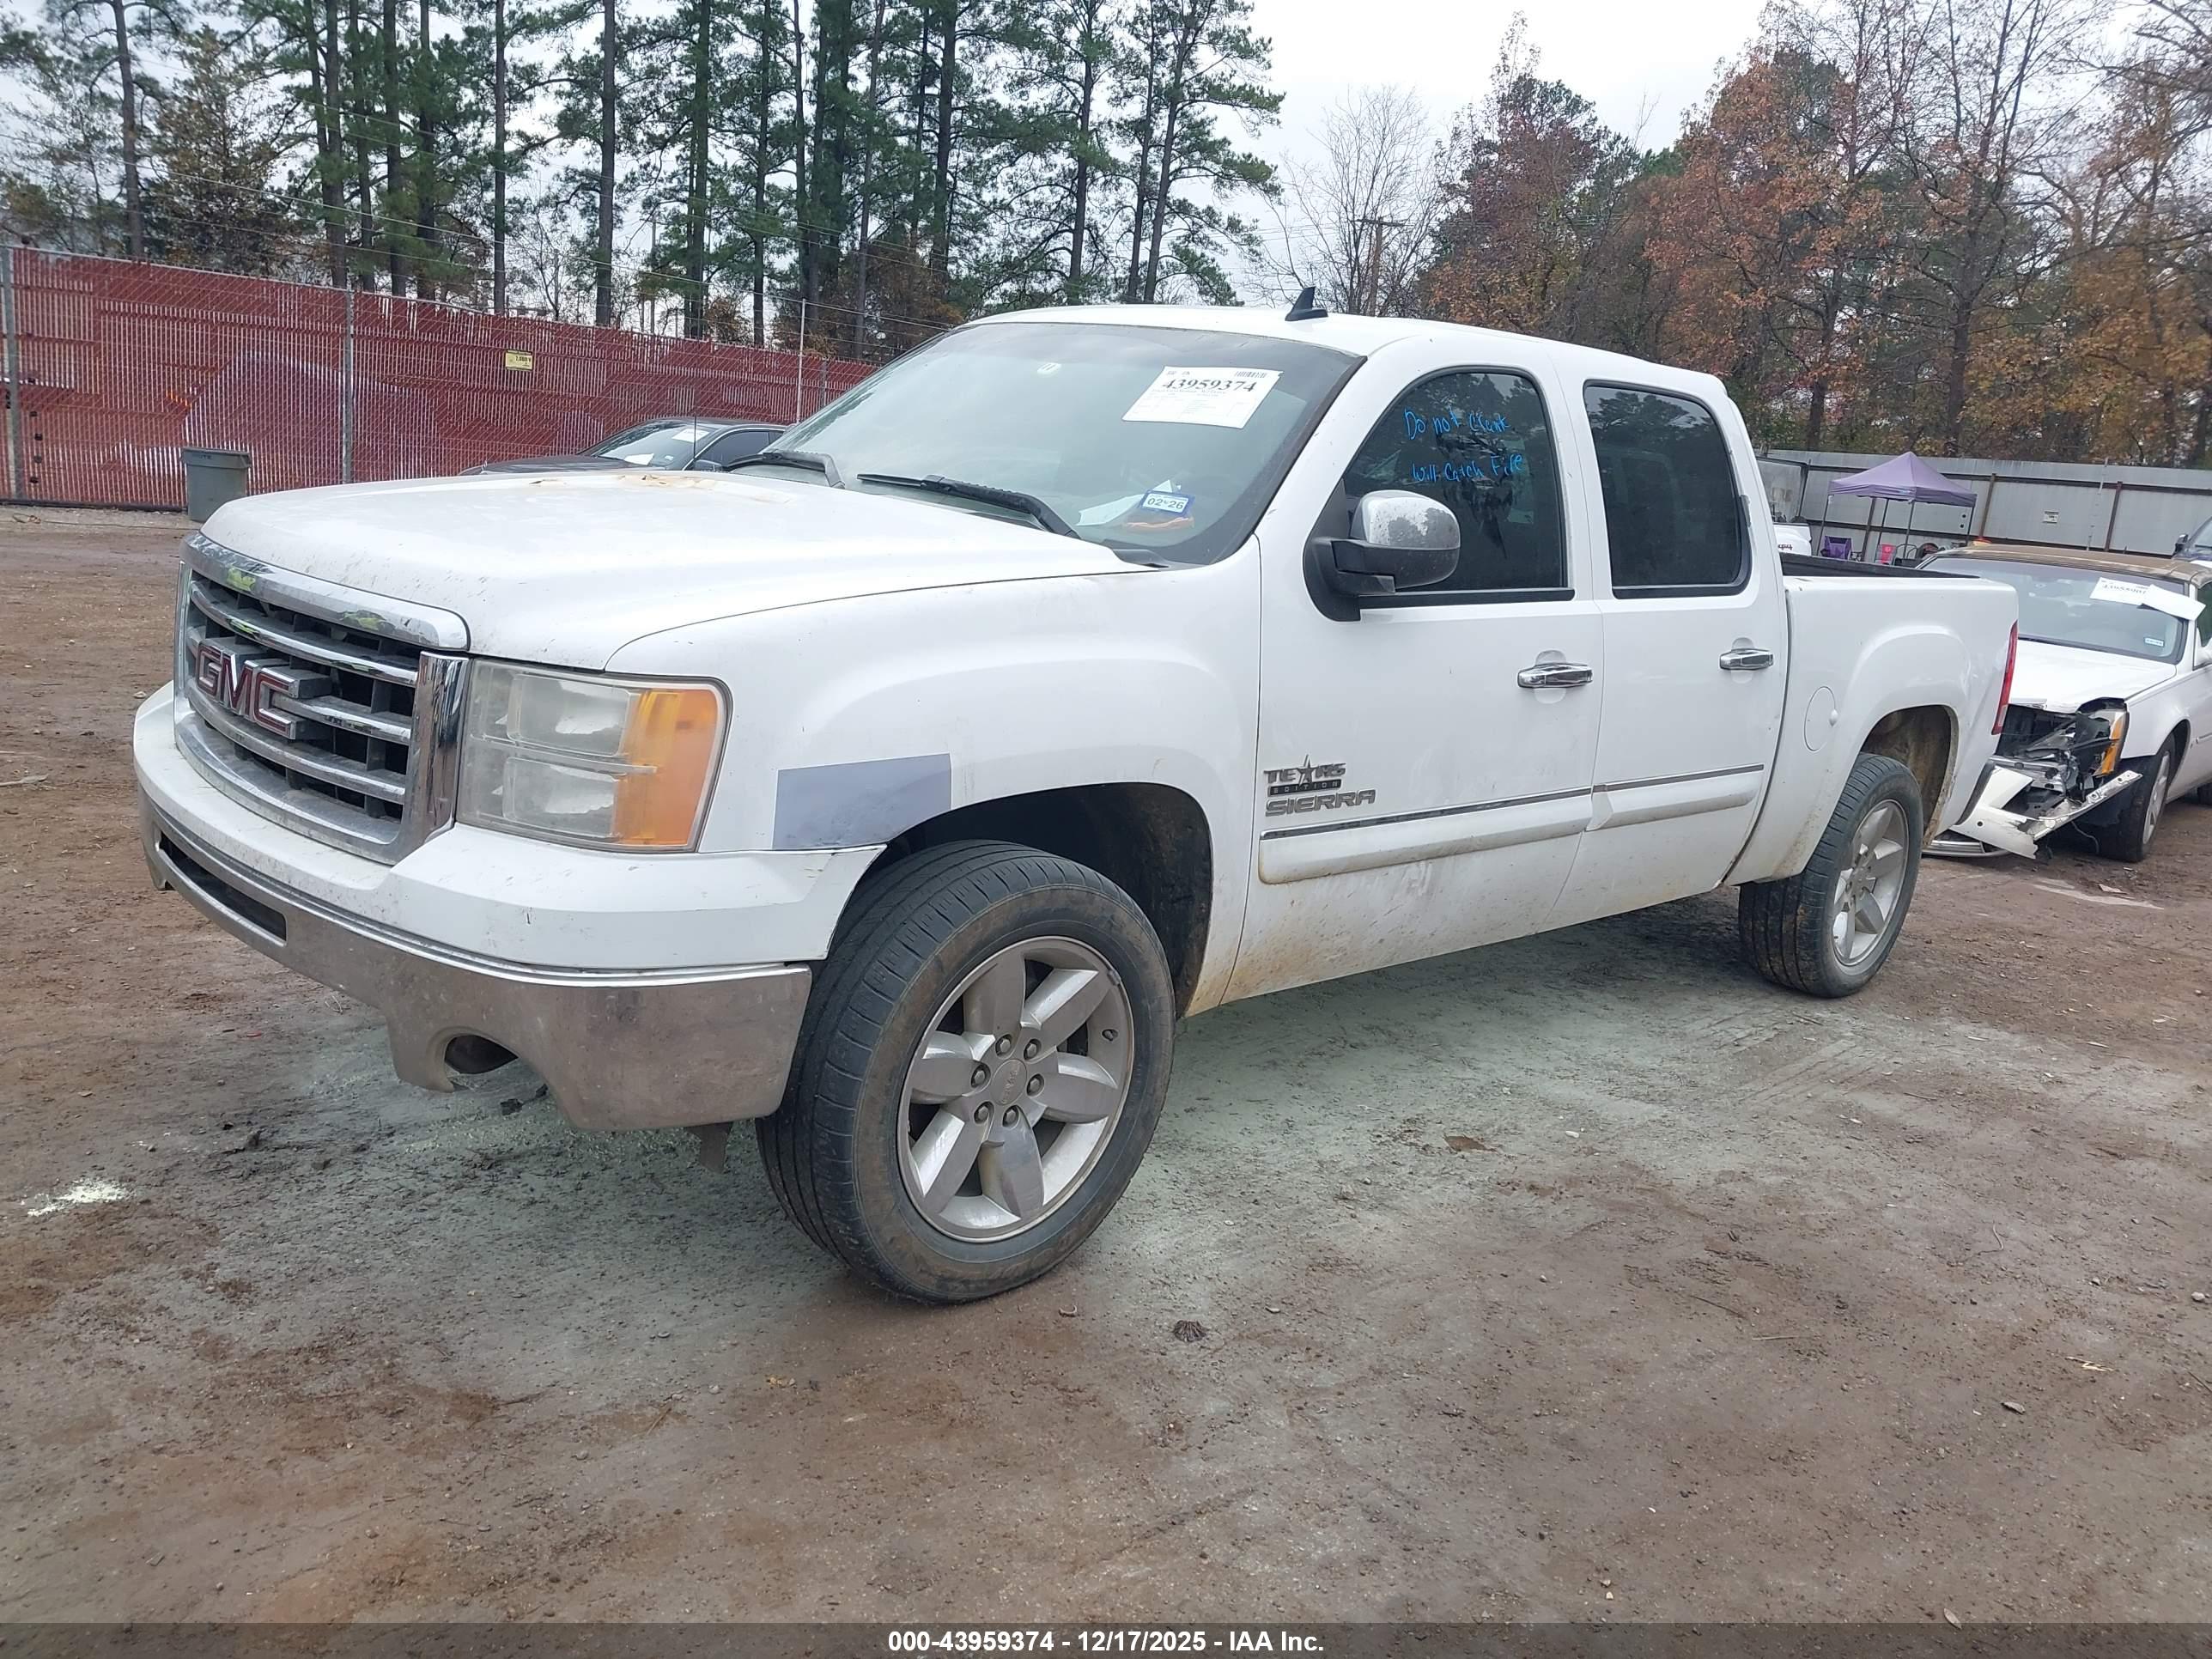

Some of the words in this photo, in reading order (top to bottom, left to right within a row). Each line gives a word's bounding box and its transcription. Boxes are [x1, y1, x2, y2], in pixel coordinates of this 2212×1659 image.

[1162, 379, 1257, 392] 43959374
[1404, 407, 1426, 440] Do
[1432, 404, 1461, 434] not
[1412, 462, 1437, 483] Will
[1444, 460, 1485, 483] Catch
[1491, 453, 1522, 477] Fire
[198, 642, 299, 740] GMC
[1273, 781, 1340, 794] EDITION
[1265, 789, 1376, 817] SIERRA
